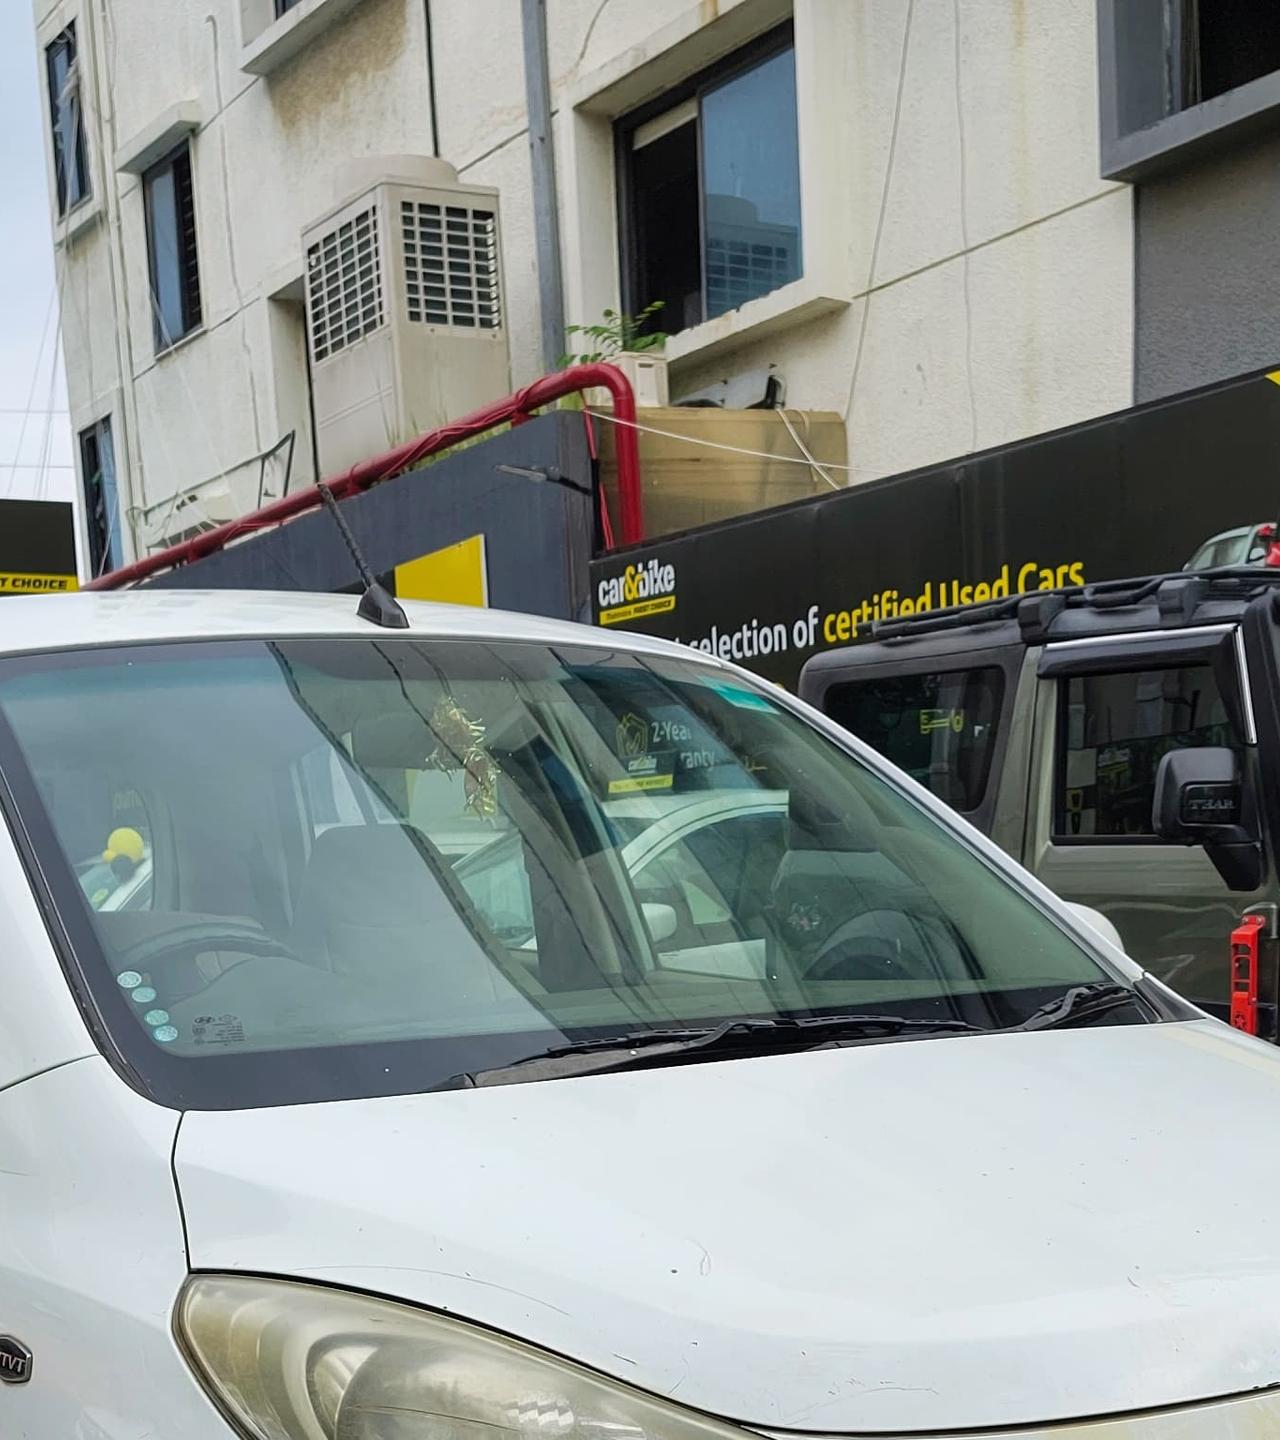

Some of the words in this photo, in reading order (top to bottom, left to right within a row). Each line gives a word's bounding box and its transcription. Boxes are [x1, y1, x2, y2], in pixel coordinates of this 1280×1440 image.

[11, 577, 68, 590] CHOICE
[598, 559, 676, 607] car&bike
[793, 605, 819, 649] of
[823, 581, 931, 643] certified
[939, 564, 1009, 609] Used
[1017, 561, 1085, 595] Cars
